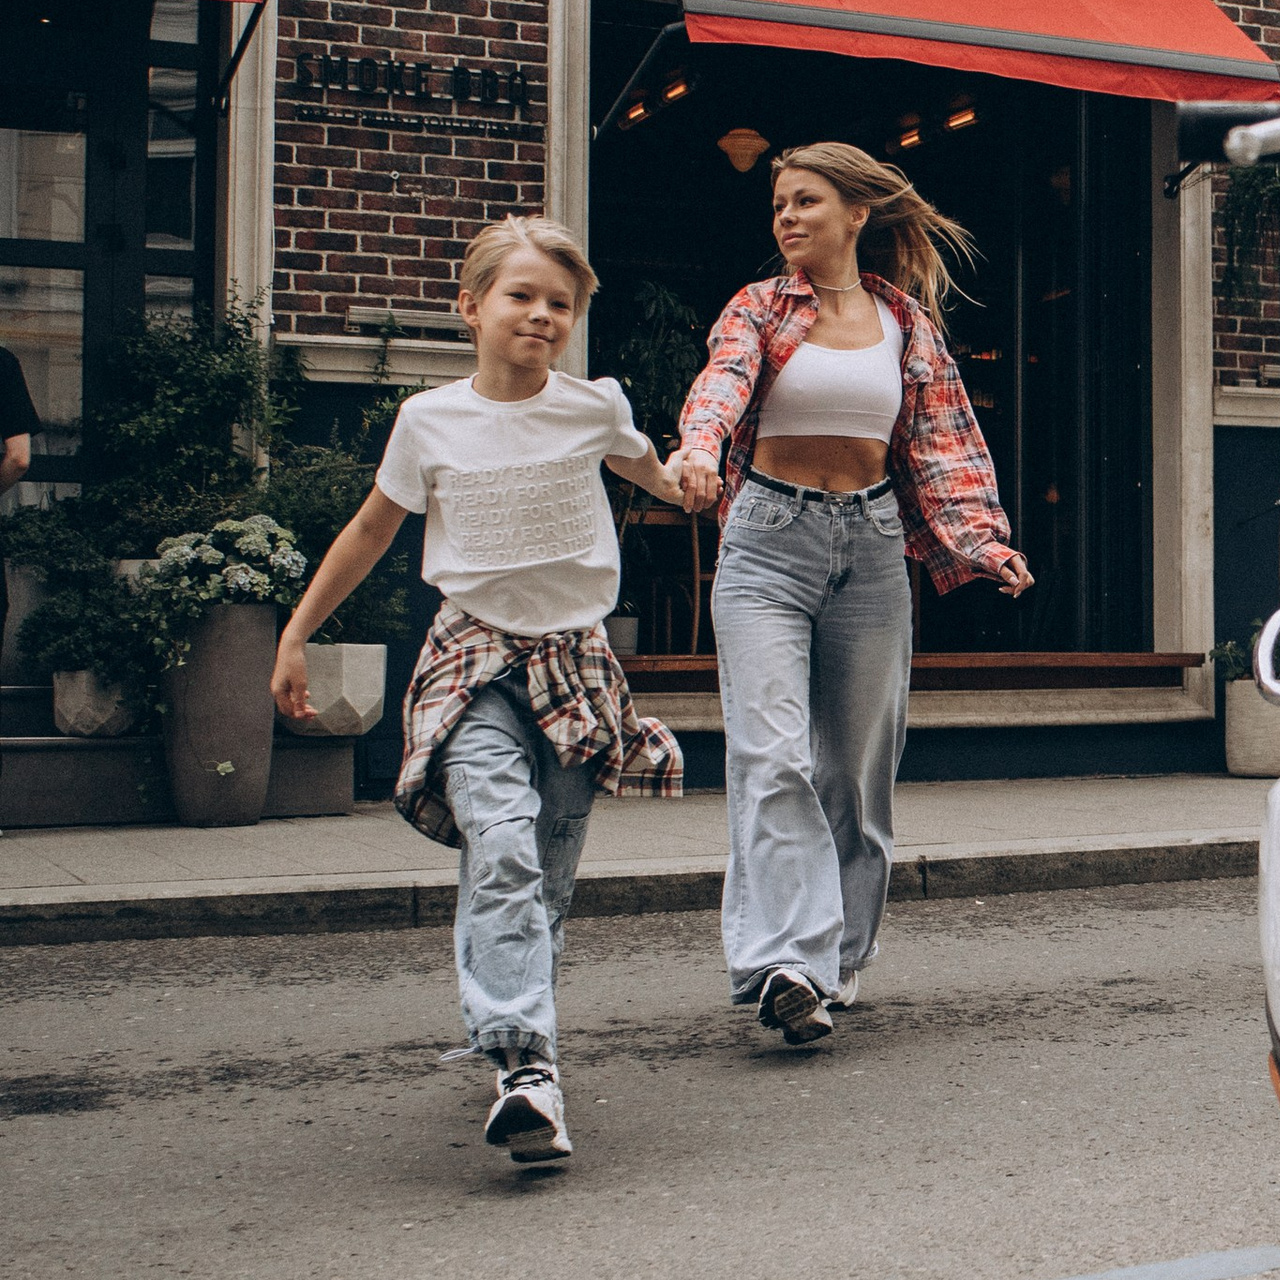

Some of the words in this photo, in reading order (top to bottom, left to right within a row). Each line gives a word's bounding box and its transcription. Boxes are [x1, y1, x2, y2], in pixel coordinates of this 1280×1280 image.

[296, 52, 432, 99] SMOKE
[453, 66, 531, 108] BBQ
[449, 469, 505, 487] READY
[512, 463, 549, 479] FOR
[553, 456, 592, 473] THAT
[453, 488, 510, 508] READY
[515, 483, 553, 500] FOR
[556, 473, 593, 492] THAT
[458, 508, 512, 528] READY
[518, 503, 554, 519] FOR
[558, 493, 593, 512] THAT
[461, 528, 515, 548] READY
[521, 522, 557, 539] FOR
[562, 511, 594, 532] THAT
[466, 549, 519, 566] READY
[525, 543, 560, 559] FOR
